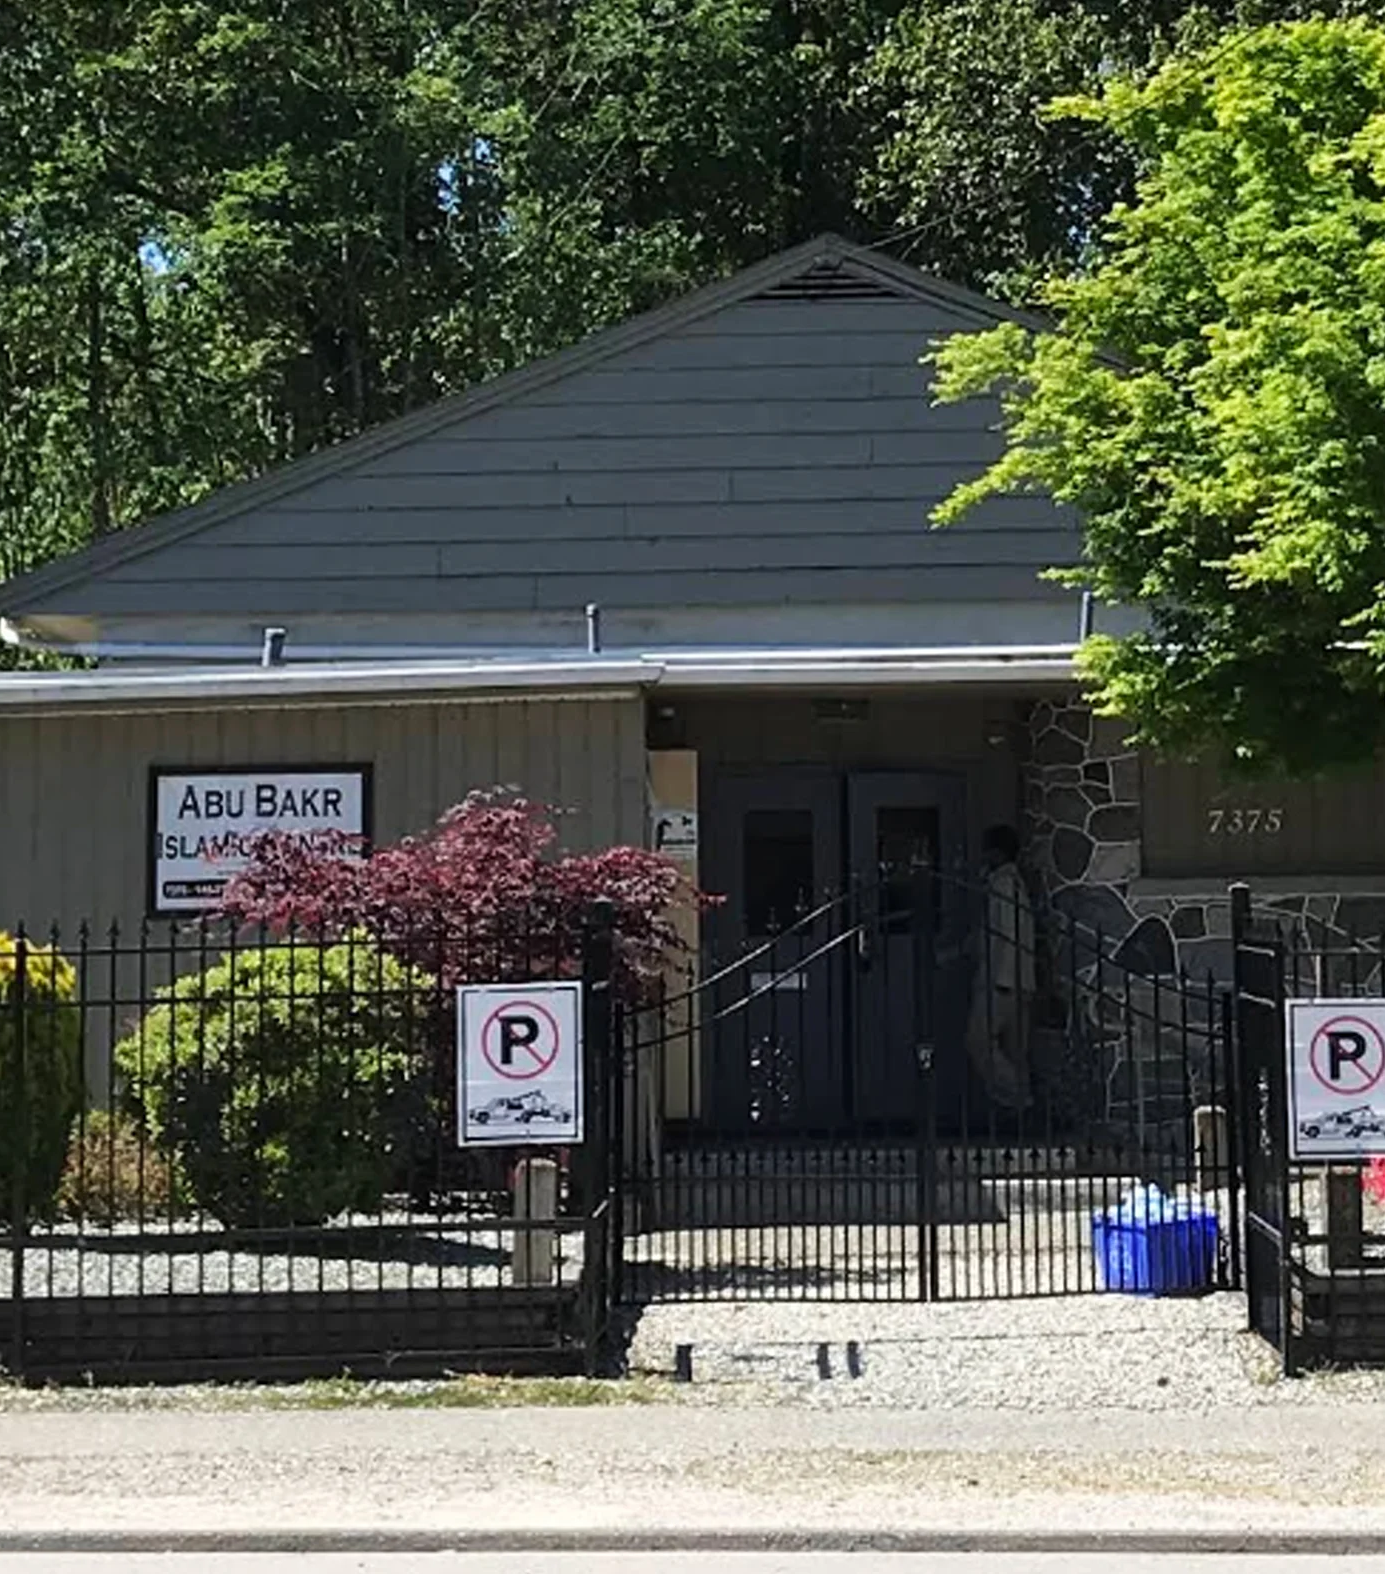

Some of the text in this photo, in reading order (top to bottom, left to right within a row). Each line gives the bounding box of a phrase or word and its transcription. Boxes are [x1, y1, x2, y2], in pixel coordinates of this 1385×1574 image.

[178, 783, 343, 819] ABU BAKR
[1208, 809, 1283, 833] 7375
[155, 831, 253, 860] ISLAMC
[500, 1015, 539, 1065] P
[1326, 1031, 1367, 1080] P
